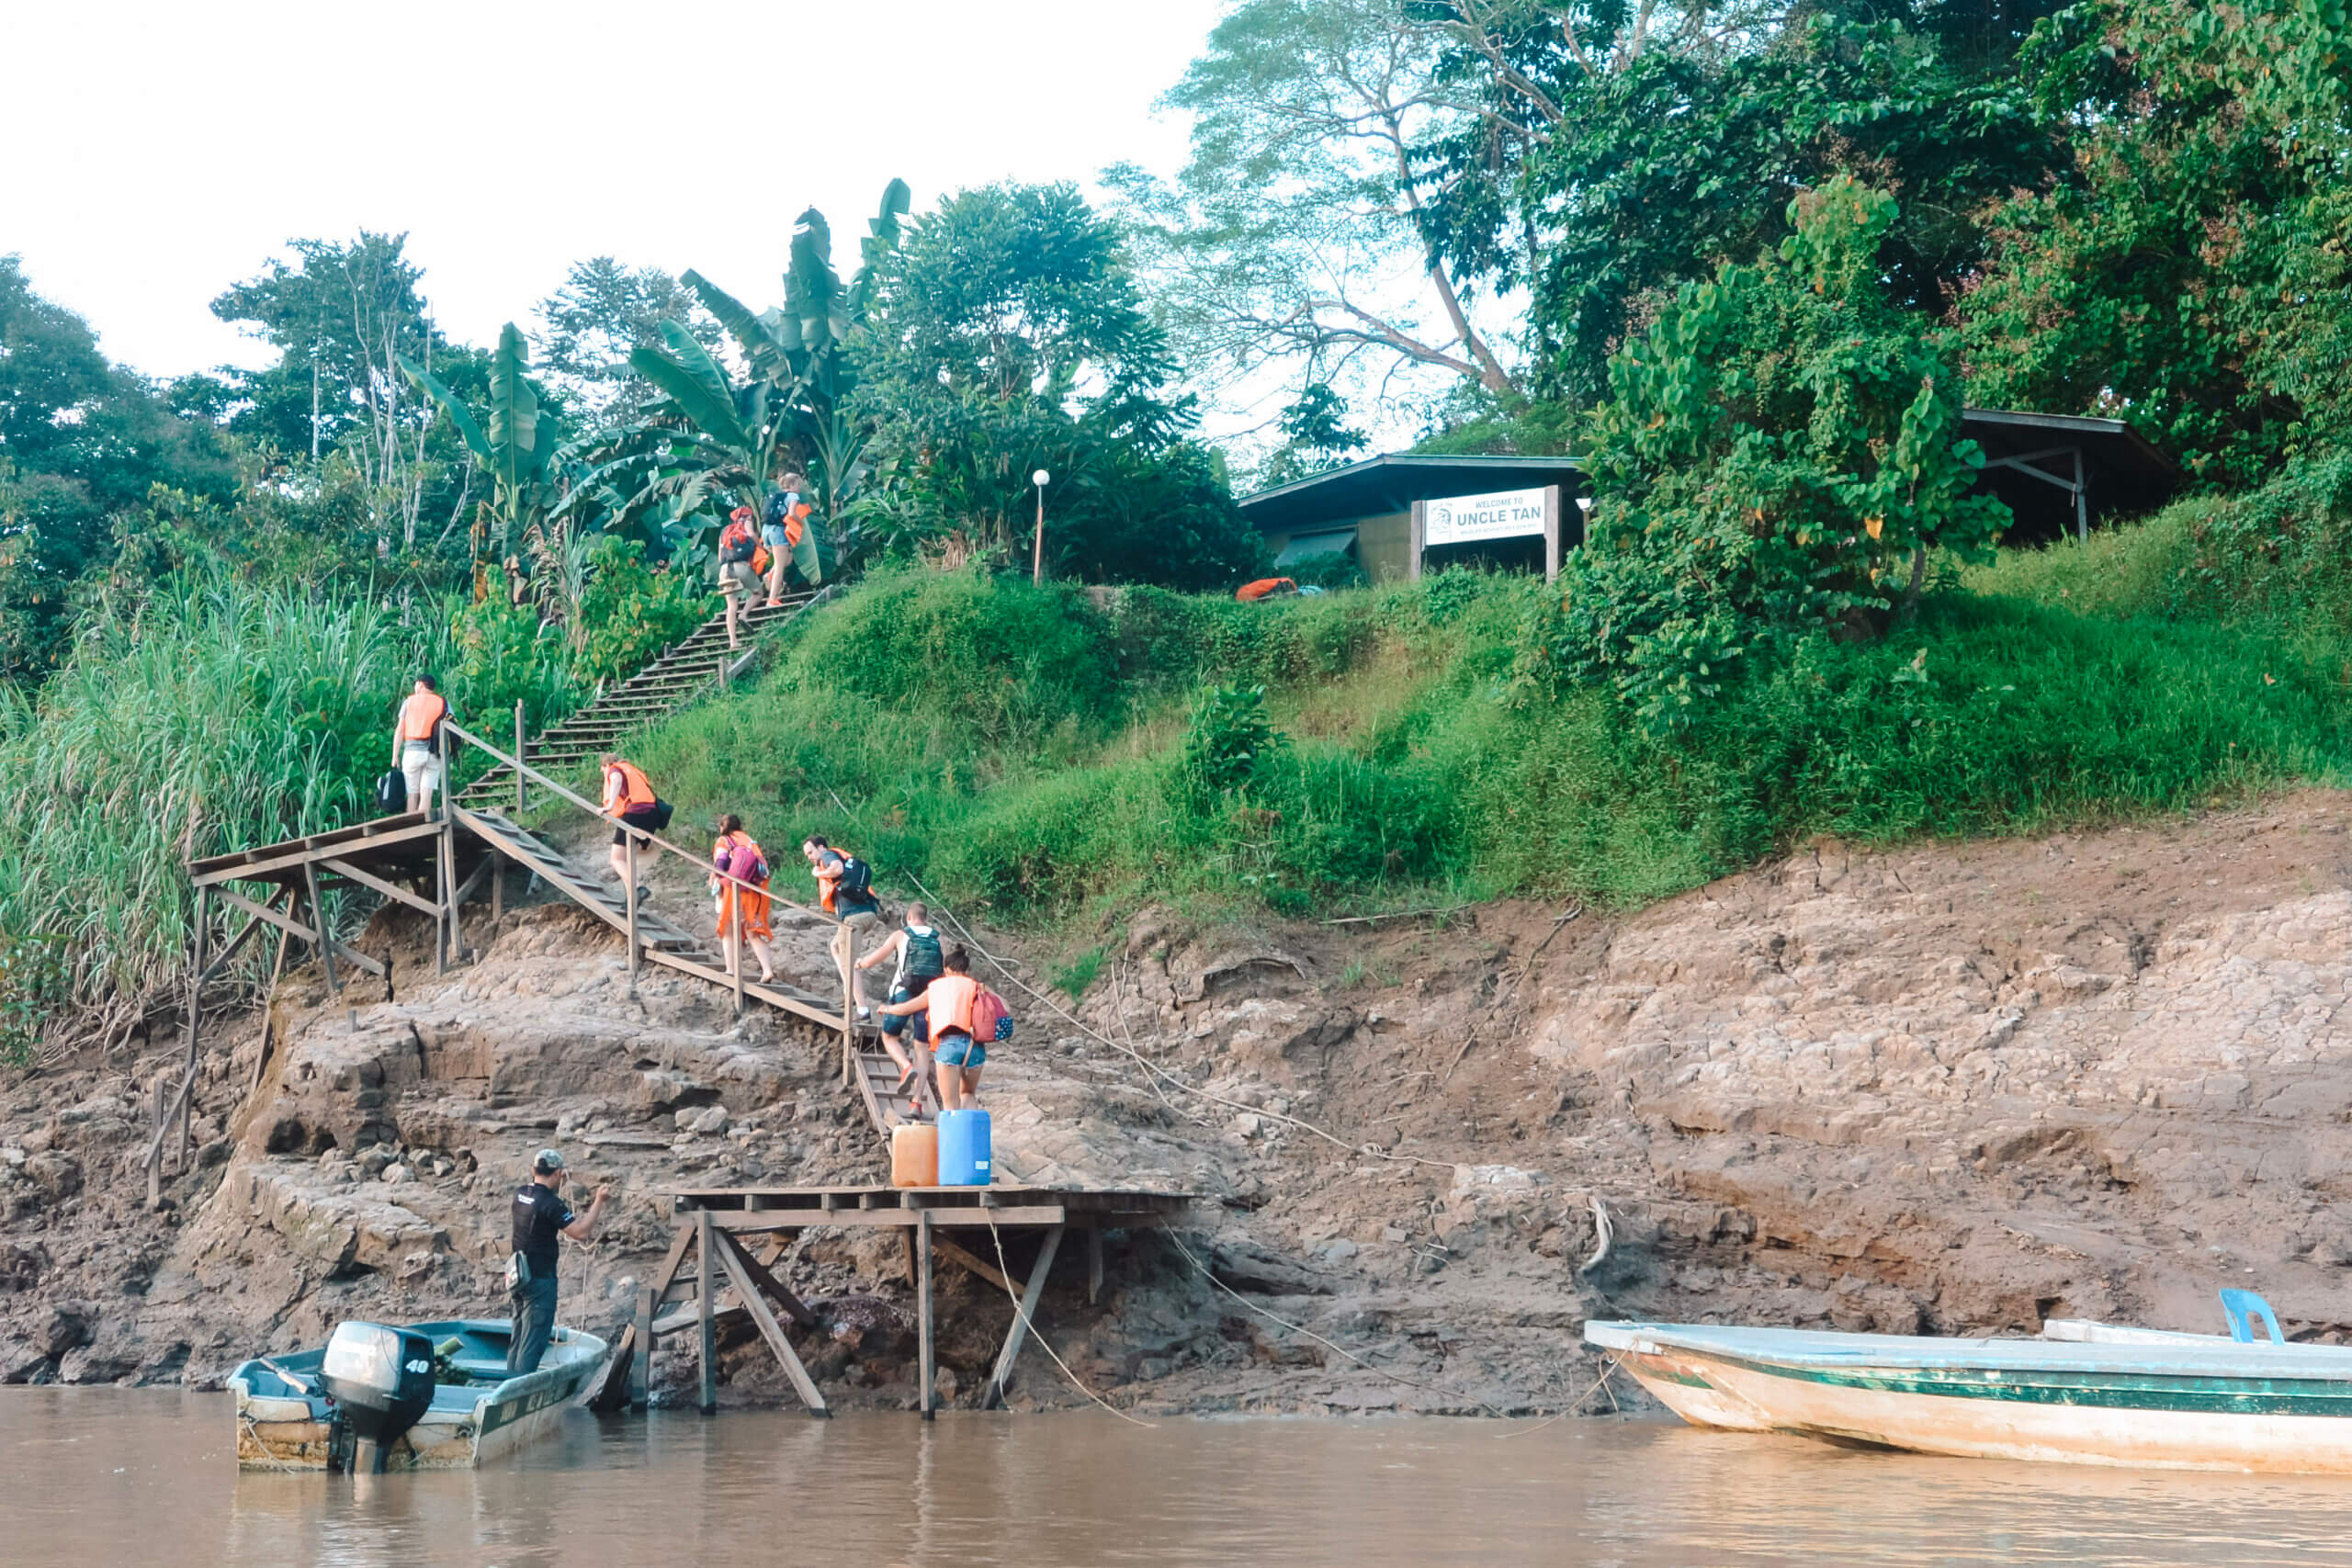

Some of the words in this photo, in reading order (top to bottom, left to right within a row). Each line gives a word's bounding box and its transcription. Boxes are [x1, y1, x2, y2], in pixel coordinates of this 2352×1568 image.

[1476, 498, 1511, 508] WELCOME
[1457, 510, 1507, 525] UNCLE
[1510, 506, 1541, 521] TAN
[406, 1359, 428, 1373] 40
